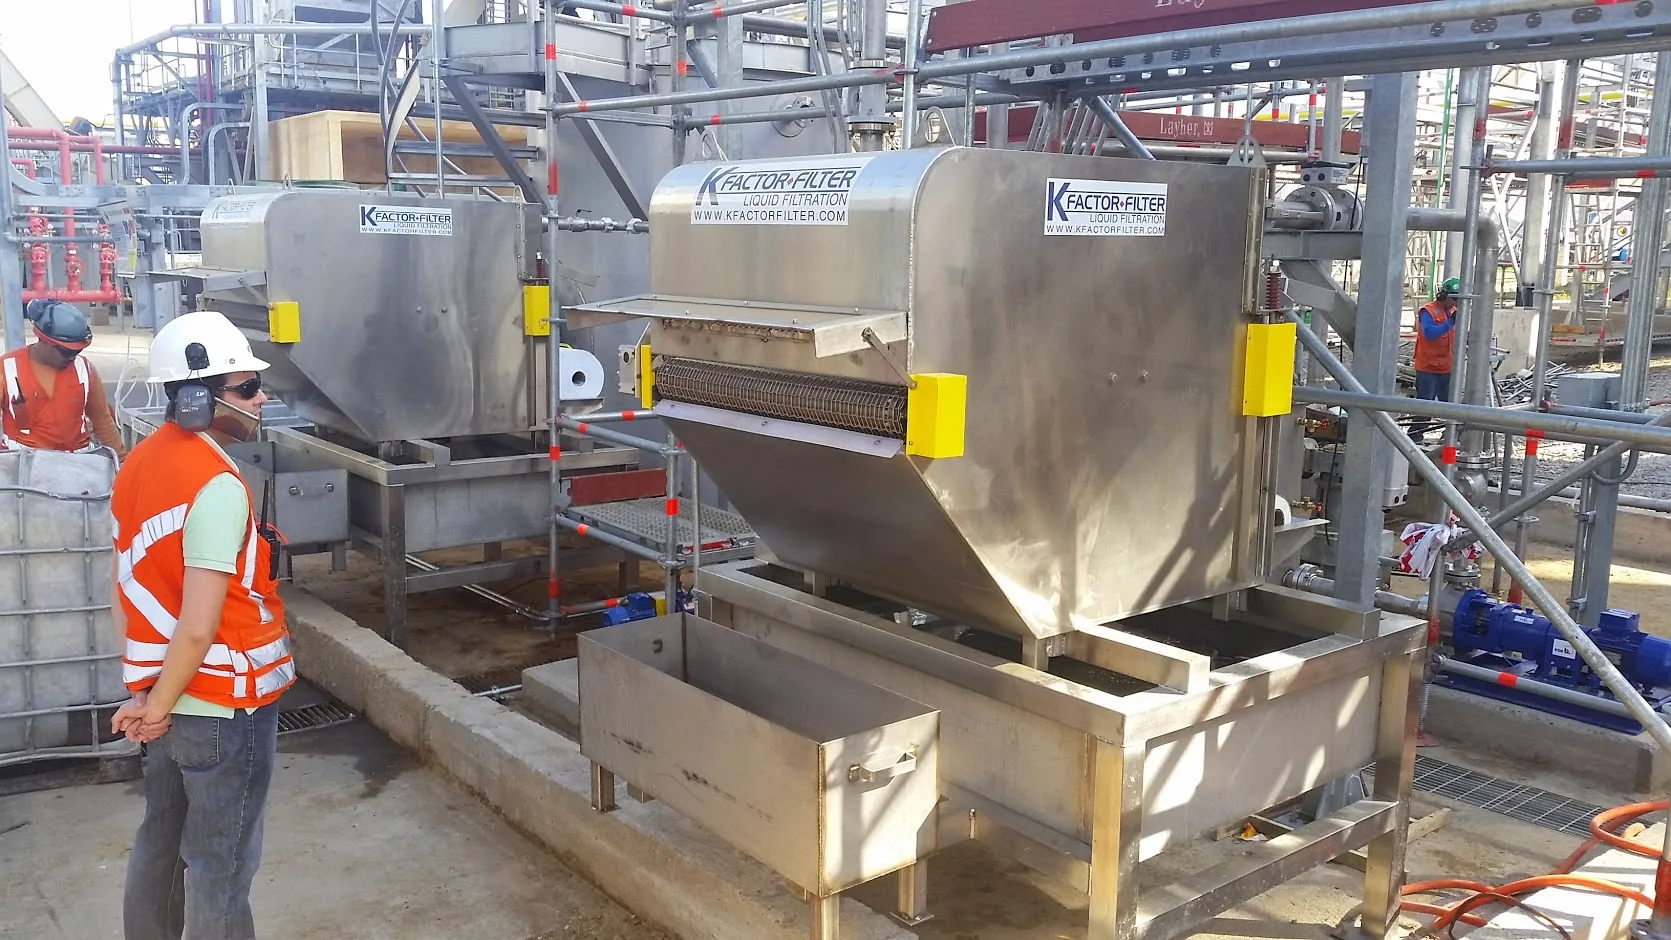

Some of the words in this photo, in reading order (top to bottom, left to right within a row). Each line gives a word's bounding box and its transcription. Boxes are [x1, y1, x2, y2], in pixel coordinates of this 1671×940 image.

[743, 195, 778, 206] LIQUID
[782, 193, 848, 206] FILTRATION
[694, 210, 845, 222] WWW.KFACTORFILTER.COM
[1089, 213, 1118, 223] LIQUID
[1120, 214, 1165, 224] FILTRATION
